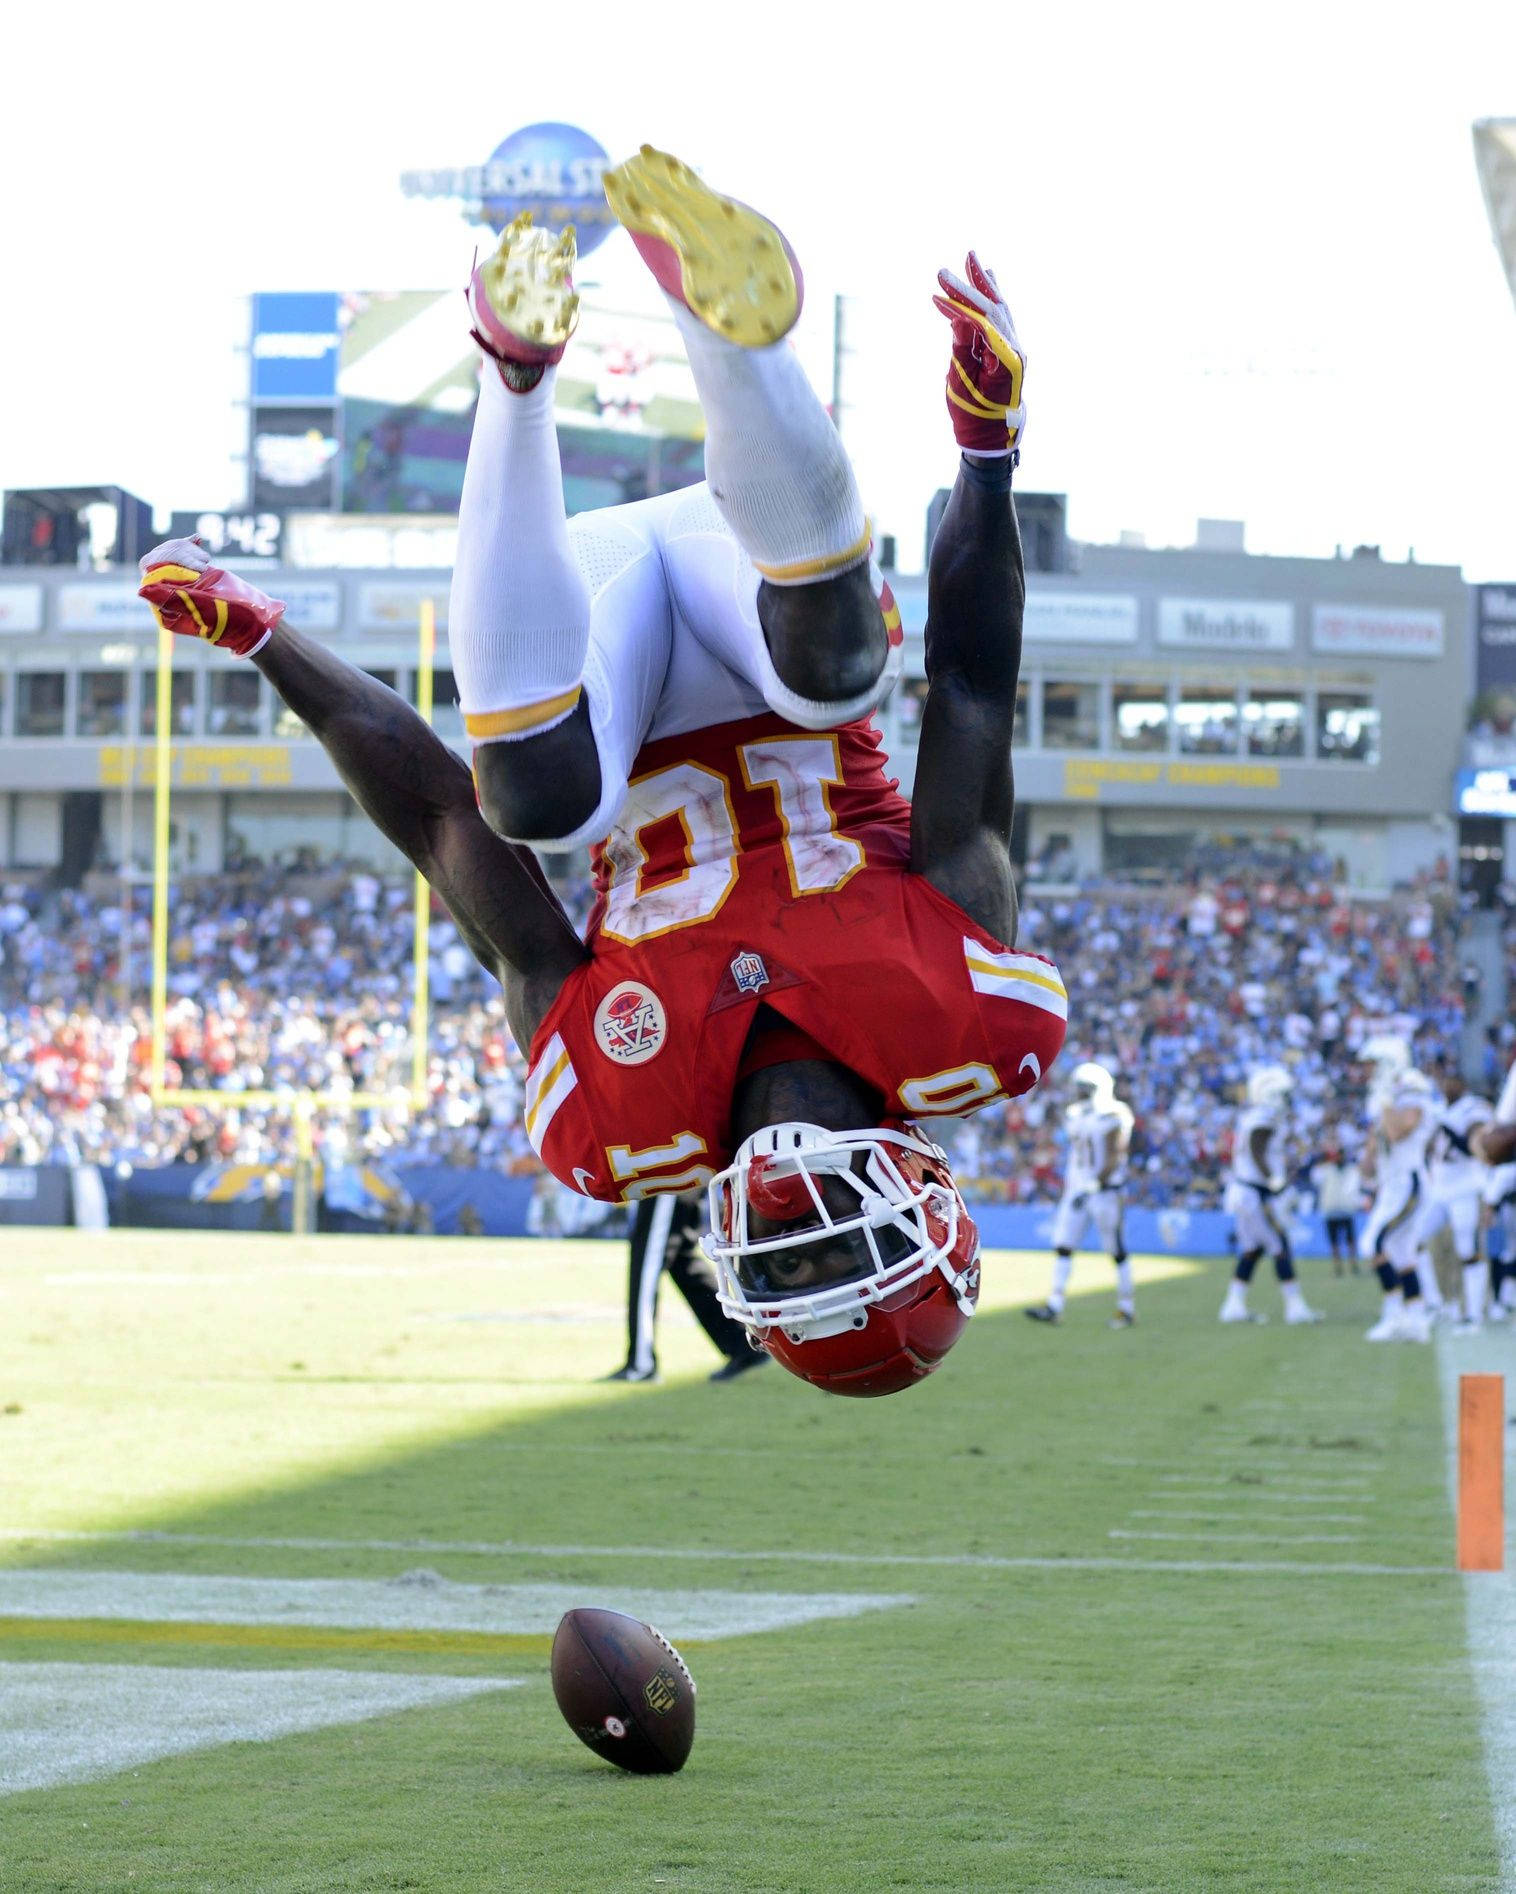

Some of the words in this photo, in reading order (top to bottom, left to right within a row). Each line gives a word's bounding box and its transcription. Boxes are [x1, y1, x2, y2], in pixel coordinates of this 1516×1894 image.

[600, 734, 867, 947] 10
[737, 958, 758, 977] NFL
[605, 1130, 717, 1207] 10
[647, 1676, 675, 1714] NFL
